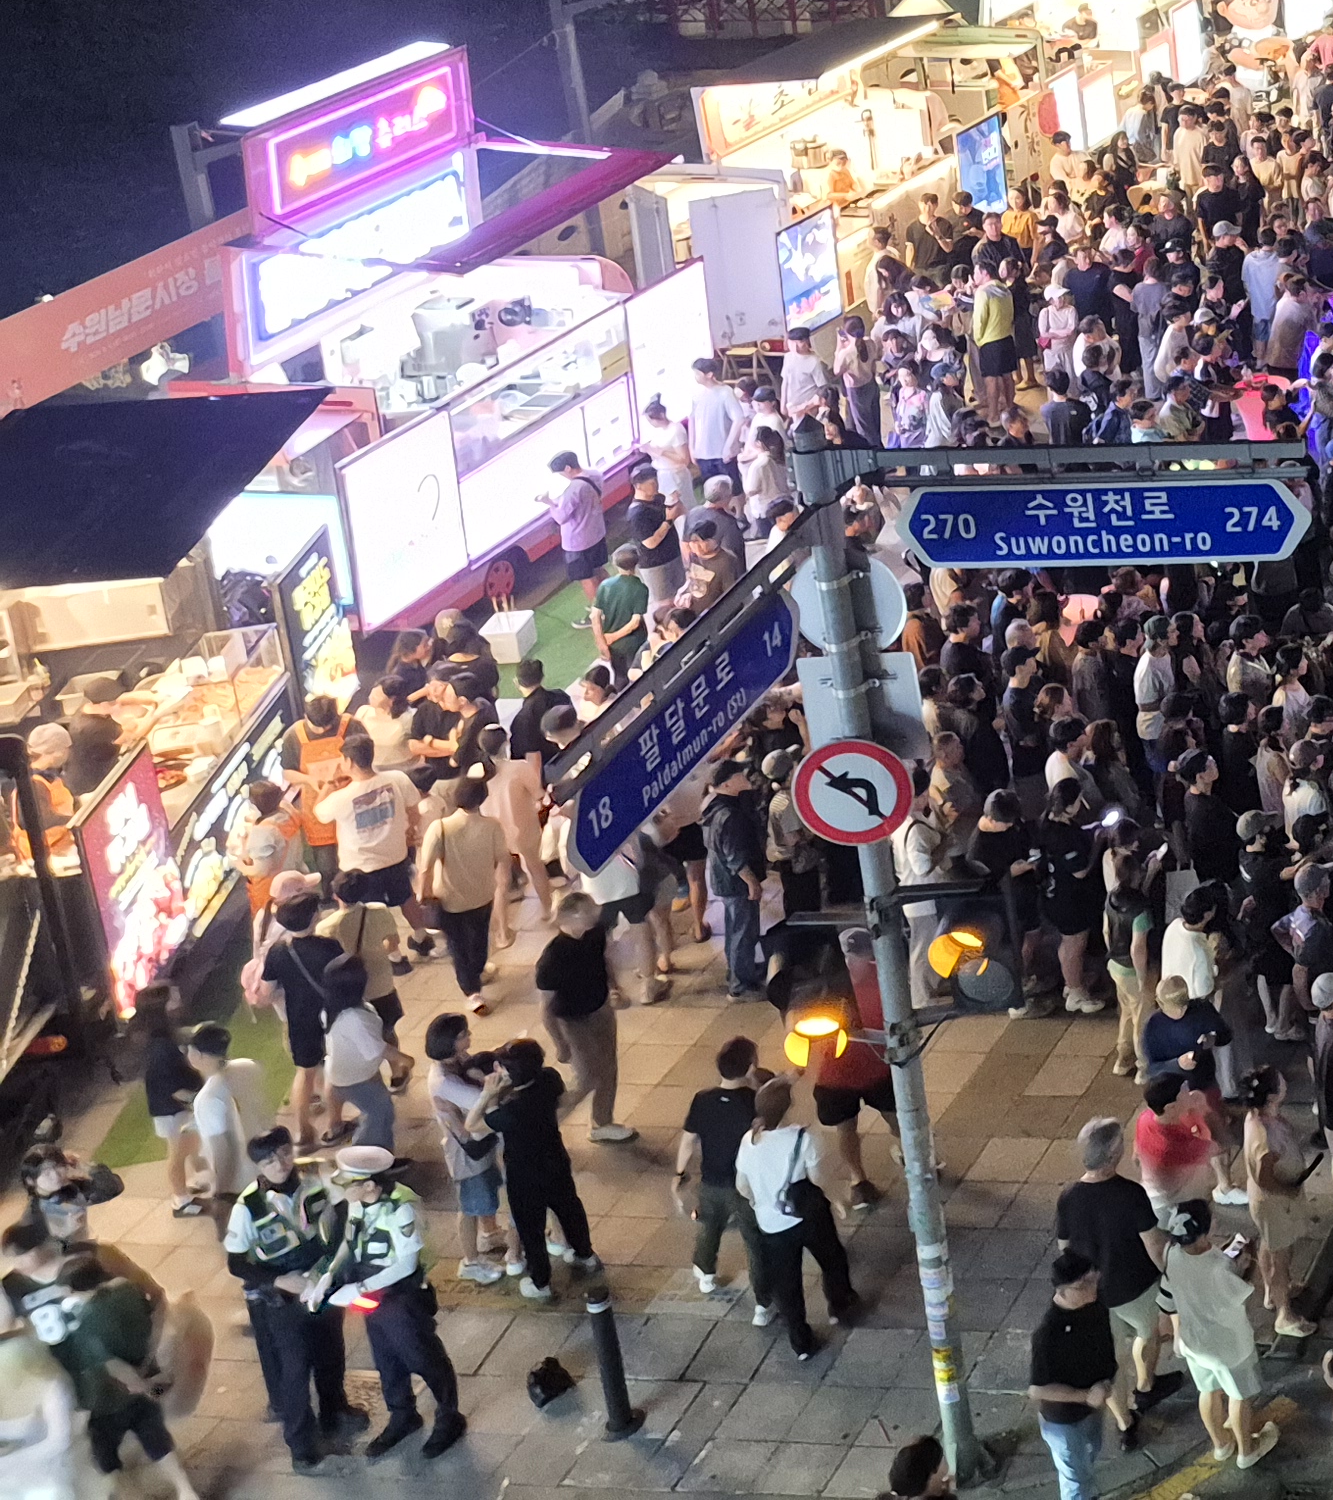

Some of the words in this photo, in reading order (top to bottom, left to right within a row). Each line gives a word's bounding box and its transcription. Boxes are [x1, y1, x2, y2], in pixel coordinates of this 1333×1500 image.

[1025, 491, 1176, 526] 수원천로
[1224, 505, 1282, 534] 274
[920, 514, 977, 541] 270
[994, 529, 1212, 556] Suwoncheon-ro
[763, 621, 782, 657] 14
[638, 650, 735, 773] 팔달문로
[642, 714, 725, 808] Paldalmun-ro
[586, 795, 613, 840] 18
